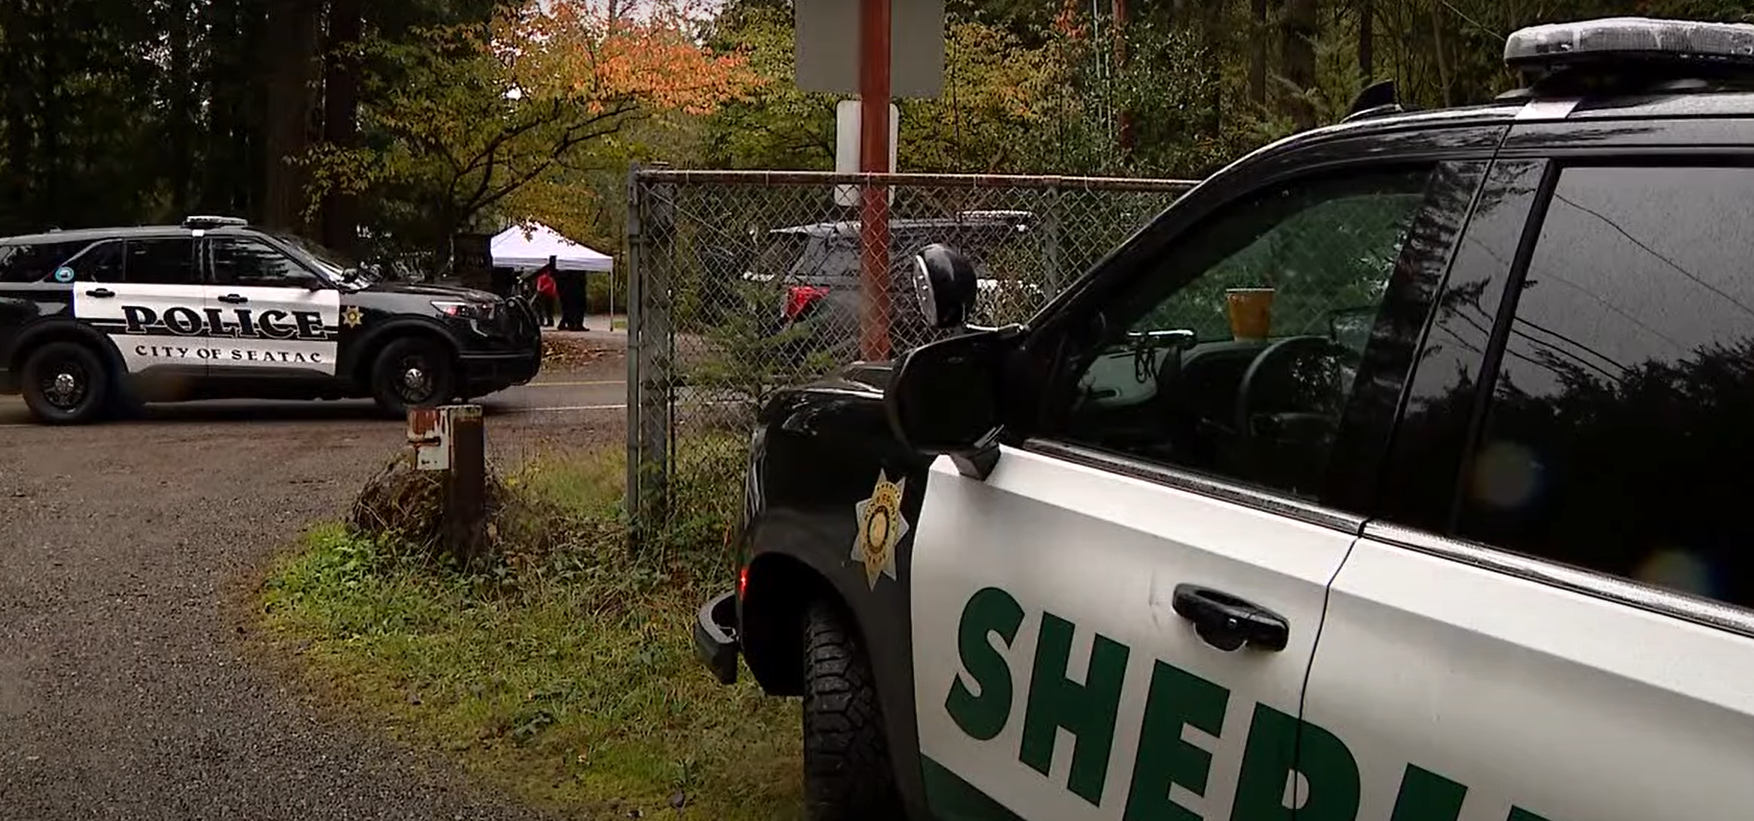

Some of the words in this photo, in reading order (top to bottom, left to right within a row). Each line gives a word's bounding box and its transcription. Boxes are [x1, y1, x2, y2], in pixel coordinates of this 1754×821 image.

[121, 305, 328, 339] POLICE
[135, 345, 189, 358] CITY
[196, 347, 222, 360] OF
[231, 349, 322, 363] SEATAC
[944, 586, 1553, 821] SHER
